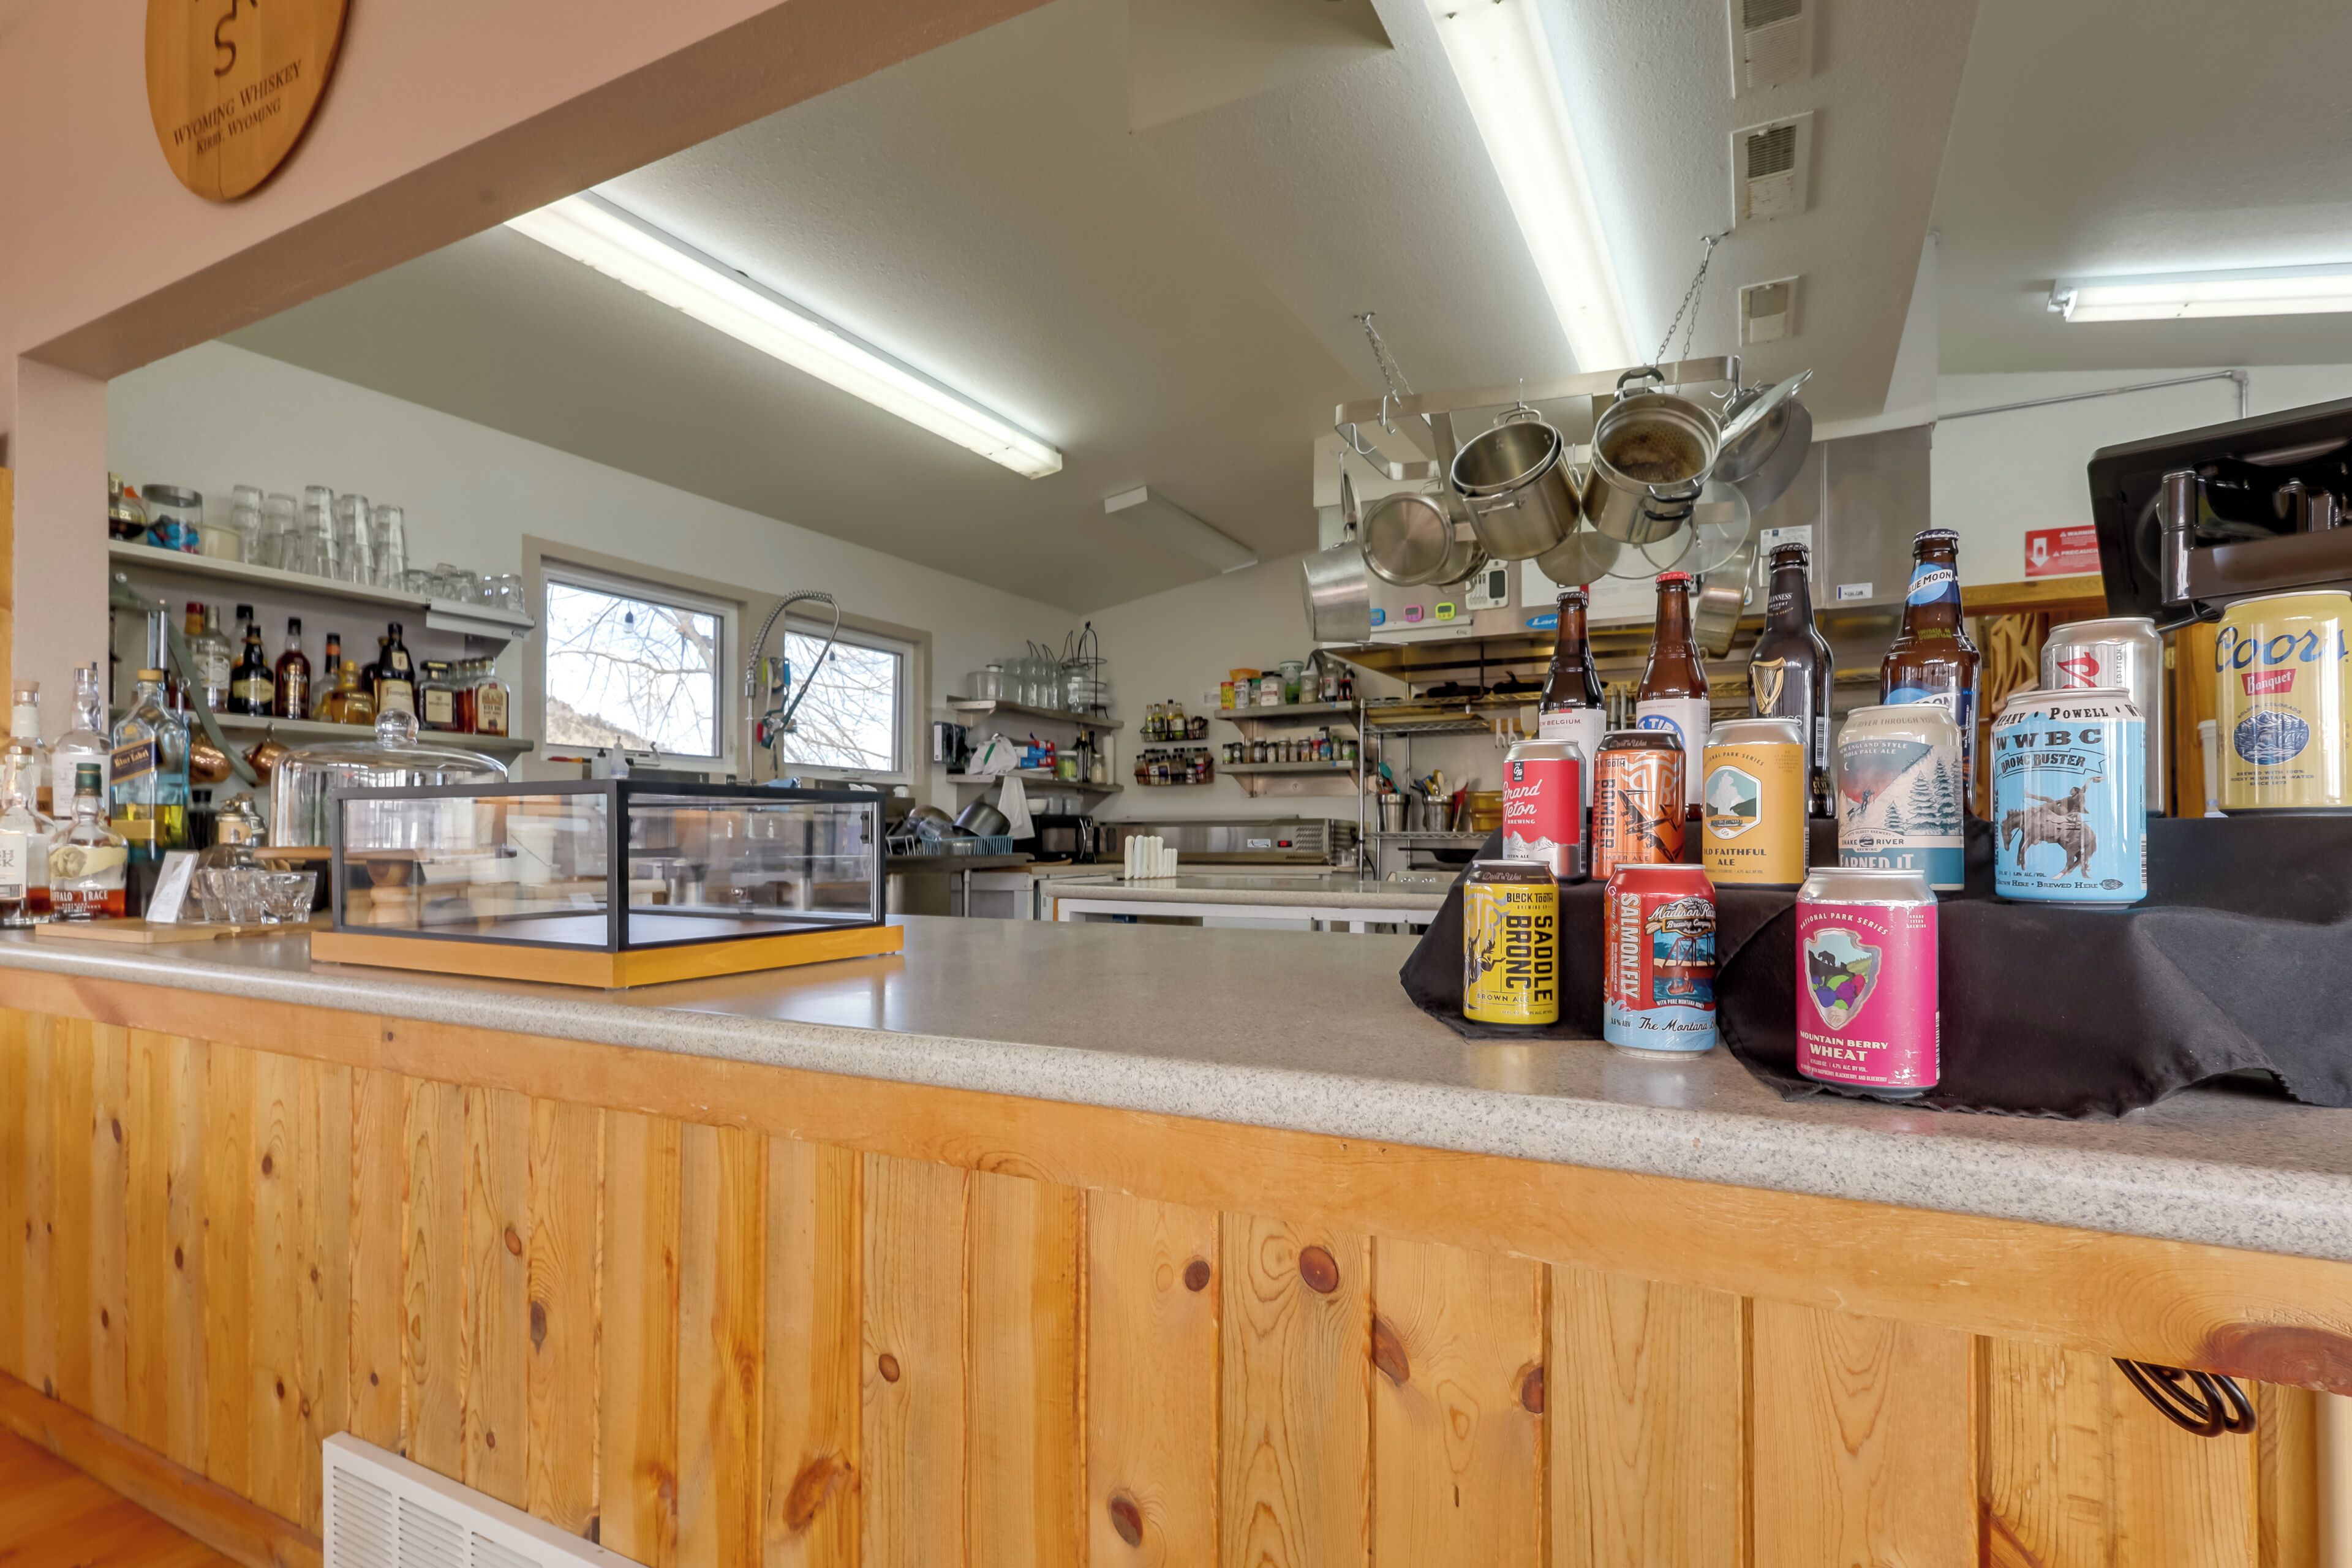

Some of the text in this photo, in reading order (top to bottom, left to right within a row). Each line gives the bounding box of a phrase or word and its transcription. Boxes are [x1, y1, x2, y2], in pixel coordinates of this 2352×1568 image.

[173, 59, 301, 146] WYOMING WHISKEY
[228, 98, 281, 138] WYOMING
[1924, 571, 1952, 584] MOON
[2215, 627, 2350, 673] Coors
[2247, 671, 2291, 695] Banquet
[114, 755, 130, 767] Blue
[130, 749, 149, 763] Label
[1742, 753, 1764, 766] SERIES
[2033, 753, 2086, 767] BUSTER
[1502, 779, 1542, 801] Grand
[1504, 801, 1537, 822] Teton
[1601, 779, 1615, 848] BOMBER
[1897, 854, 1914, 869] IT
[82, 890, 108, 902] TRACE
[1648, 903, 1700, 920] Madison
[1667, 920, 1692, 929] Brewing
[1800, 913, 1888, 935] NATIONAL PARK SERIES
[1506, 916, 1532, 989] BRONC
[1534, 916, 1553, 1002] SADDLE
[1477, 993, 1509, 1001] BROWN
[1638, 1017, 1659, 1030] The
[1662, 1019, 1708, 1031] Montana
[1800, 1030, 1888, 1049] MOUNTAIN BERRY
[1809, 1043, 1868, 1061] WHEAT
